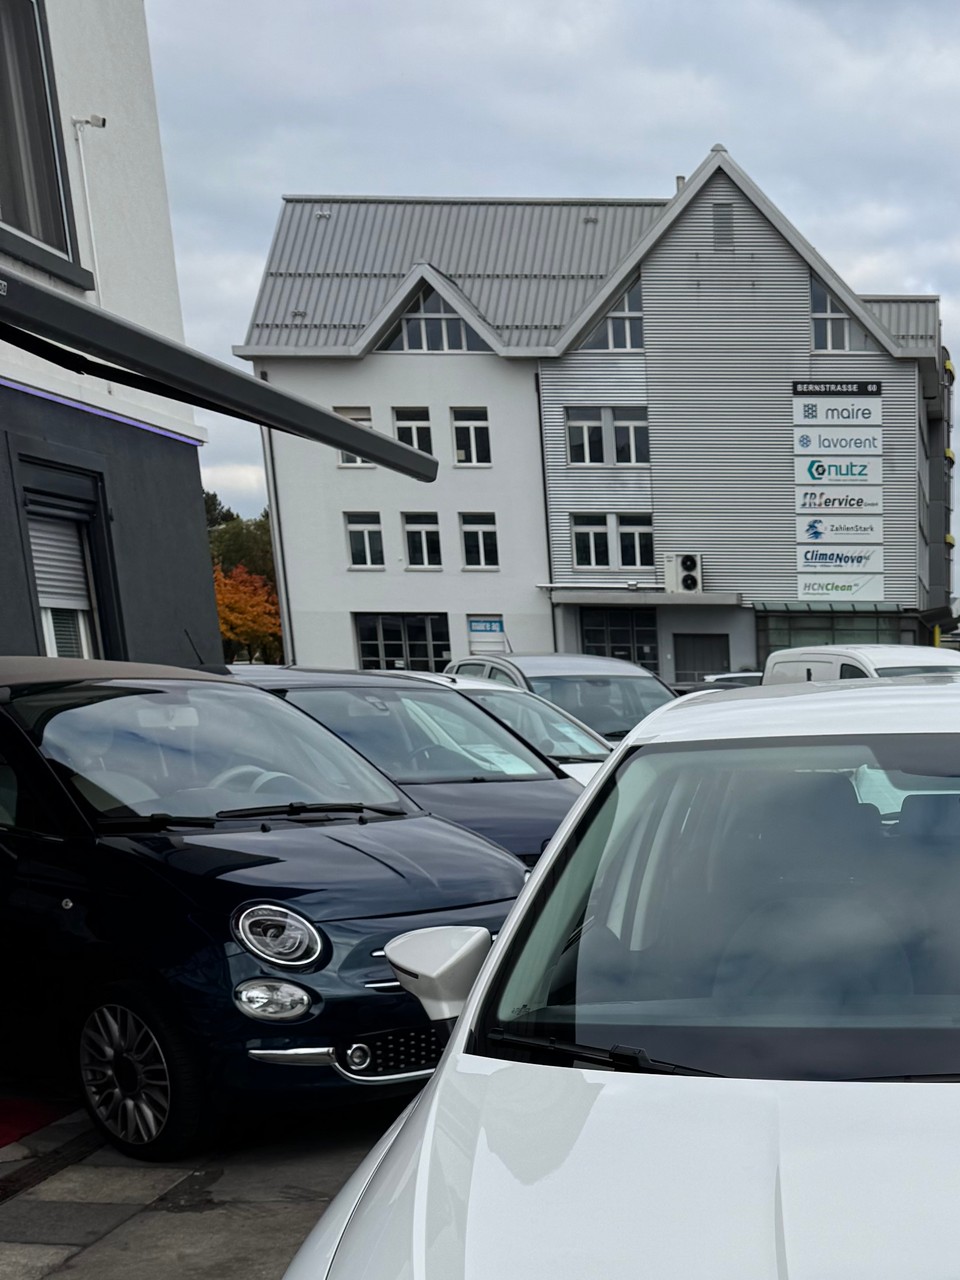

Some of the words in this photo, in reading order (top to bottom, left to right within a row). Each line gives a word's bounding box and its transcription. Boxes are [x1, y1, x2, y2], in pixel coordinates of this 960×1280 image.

[796, 384, 859, 392] BERNSTRASSE
[826, 404, 871, 419] maire
[819, 434, 877, 448] lavorent
[828, 461, 868, 476] nutz
[804, 550, 862, 563] ClimaNova
[803, 582, 852, 591] HCNClean
